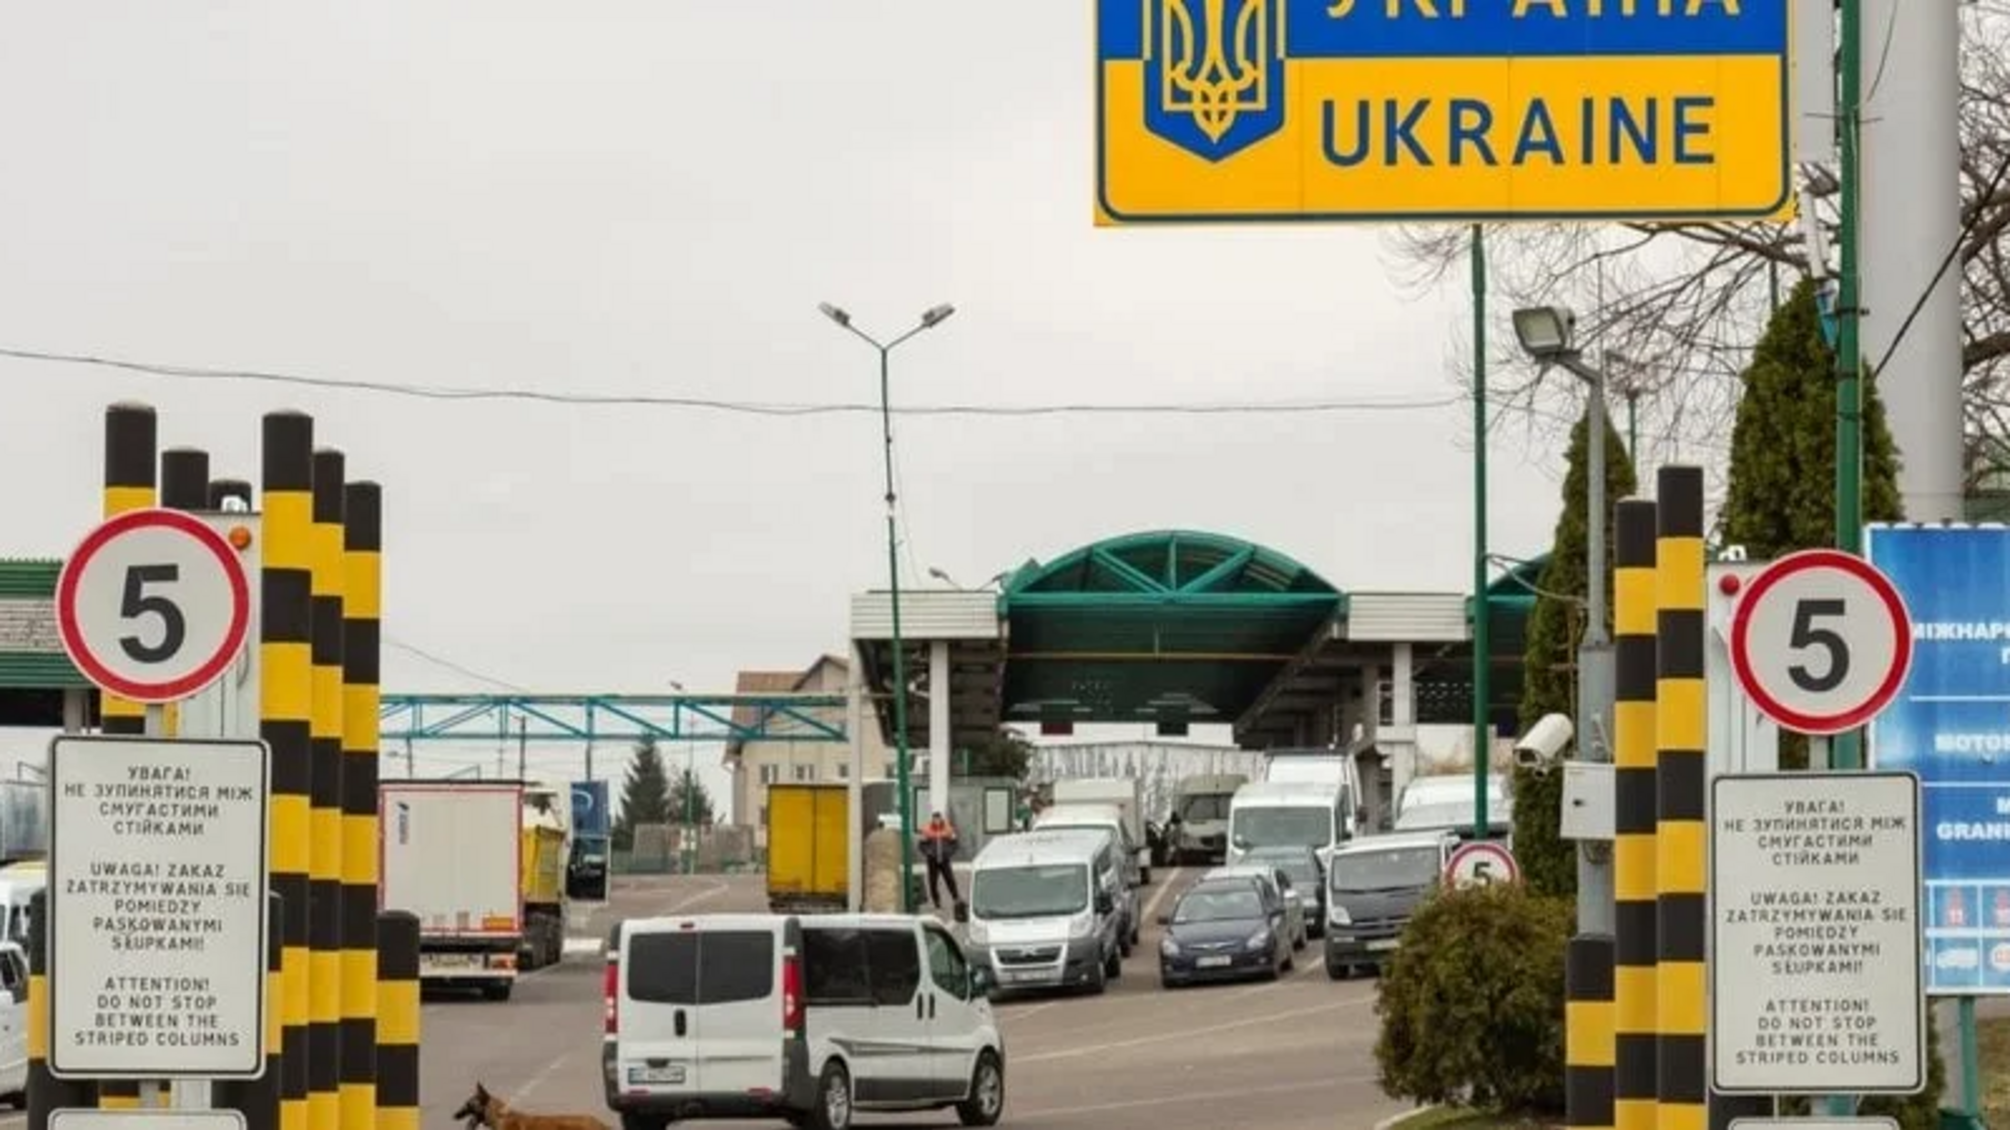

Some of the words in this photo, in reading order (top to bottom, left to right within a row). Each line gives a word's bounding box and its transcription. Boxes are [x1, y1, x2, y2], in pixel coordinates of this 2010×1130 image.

[1322, 97, 1717, 167] UKRAINE
[119, 564, 185, 664] 5
[1788, 598, 1848, 692] 5
[128, 766, 191, 781] УВАГА!
[65, 784, 85, 797] НЕ
[94, 784, 210, 800] ЗУПИНЯТИСЯ
[217, 787, 253, 801] МІЖ
[99, 802, 219, 818] СМУГАСТИМИ
[1784, 801, 1844, 814] УВАГА!
[113, 819, 204, 835] СТІЙКАМИ
[1724, 819, 1745, 832] НЕ
[1753, 818, 1863, 831] ЗУПИНЯТИСЯ
[1871, 817, 1906, 830] МІЖ
[1758, 835, 1873, 848] СМУГАСТИМИ
[1772, 851, 1859, 865] СТІЙКАМИ
[90, 862, 160, 877] UWAGA!
[168, 864, 225, 878] ZAKAZ
[1474, 861, 1492, 887] 5
[66, 879, 217, 896] ZATRZYMYWANIA
[1751, 892, 1817, 905] UWAGA!
[1826, 891, 1881, 904] ZAKAZ
[1726, 909, 1874, 923] ZATRZYMYWANIA
[93, 917, 222, 932] PASKOWANYMI
[112, 937, 205, 951] SŁUPKAMI!
[1754, 944, 1880, 956] PASKOWANYMI
[1772, 961, 1863, 975] SŁUPKAMI!
[105, 977, 210, 991] ATTENTION!
[97, 995, 121, 1009] DO
[129, 996, 162, 1009] NOT
[171, 996, 217, 1009] STOP
[1766, 999, 1869, 1012] ATTENTION!
[95, 1013, 178, 1028] BETWEEN
[187, 1014, 218, 1028] THE
[1758, 1017, 1781, 1030] DO
[1790, 1017, 1822, 1029] NOT
[1833, 1017, 1877, 1030] STOP
[75, 1031, 149, 1046] STRIPED
[156, 1032, 239, 1047] COLUMNS
[1756, 1034, 1838, 1047] BETWEEN
[1847, 1033, 1878, 1046] THE
[1736, 1051, 1808, 1064] STRIPED
[1816, 1051, 1899, 1064] COLUMNS
